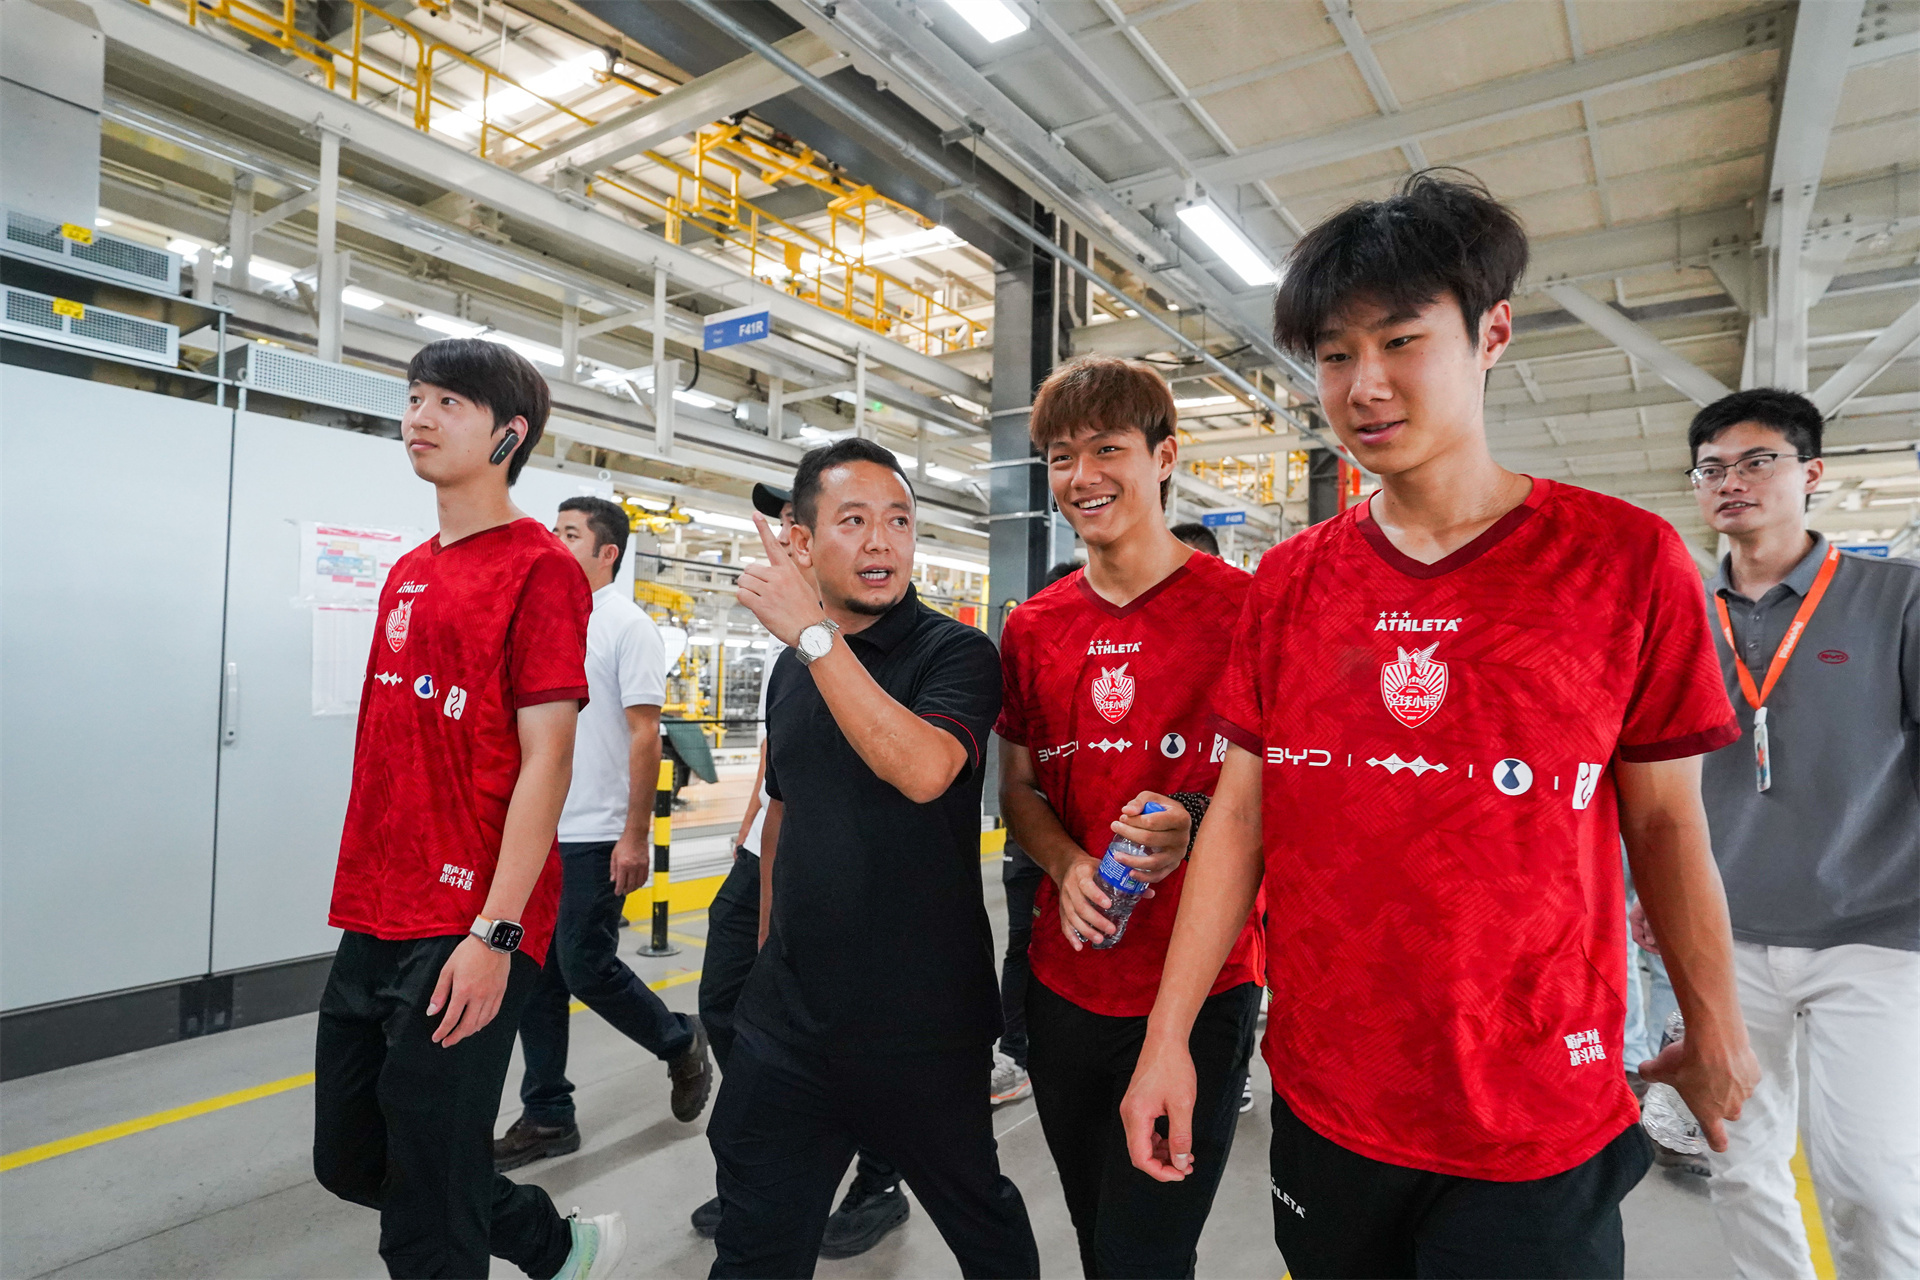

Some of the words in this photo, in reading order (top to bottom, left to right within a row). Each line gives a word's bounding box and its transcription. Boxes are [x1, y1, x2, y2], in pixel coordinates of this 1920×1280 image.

[738, 320, 764, 337] F41R
[1374, 619, 1459, 632] ATHLETA
[1087, 642, 1140, 655] ATHLETA
[1038, 741, 1076, 762] BYD
[1267, 746, 1332, 767] BYD
